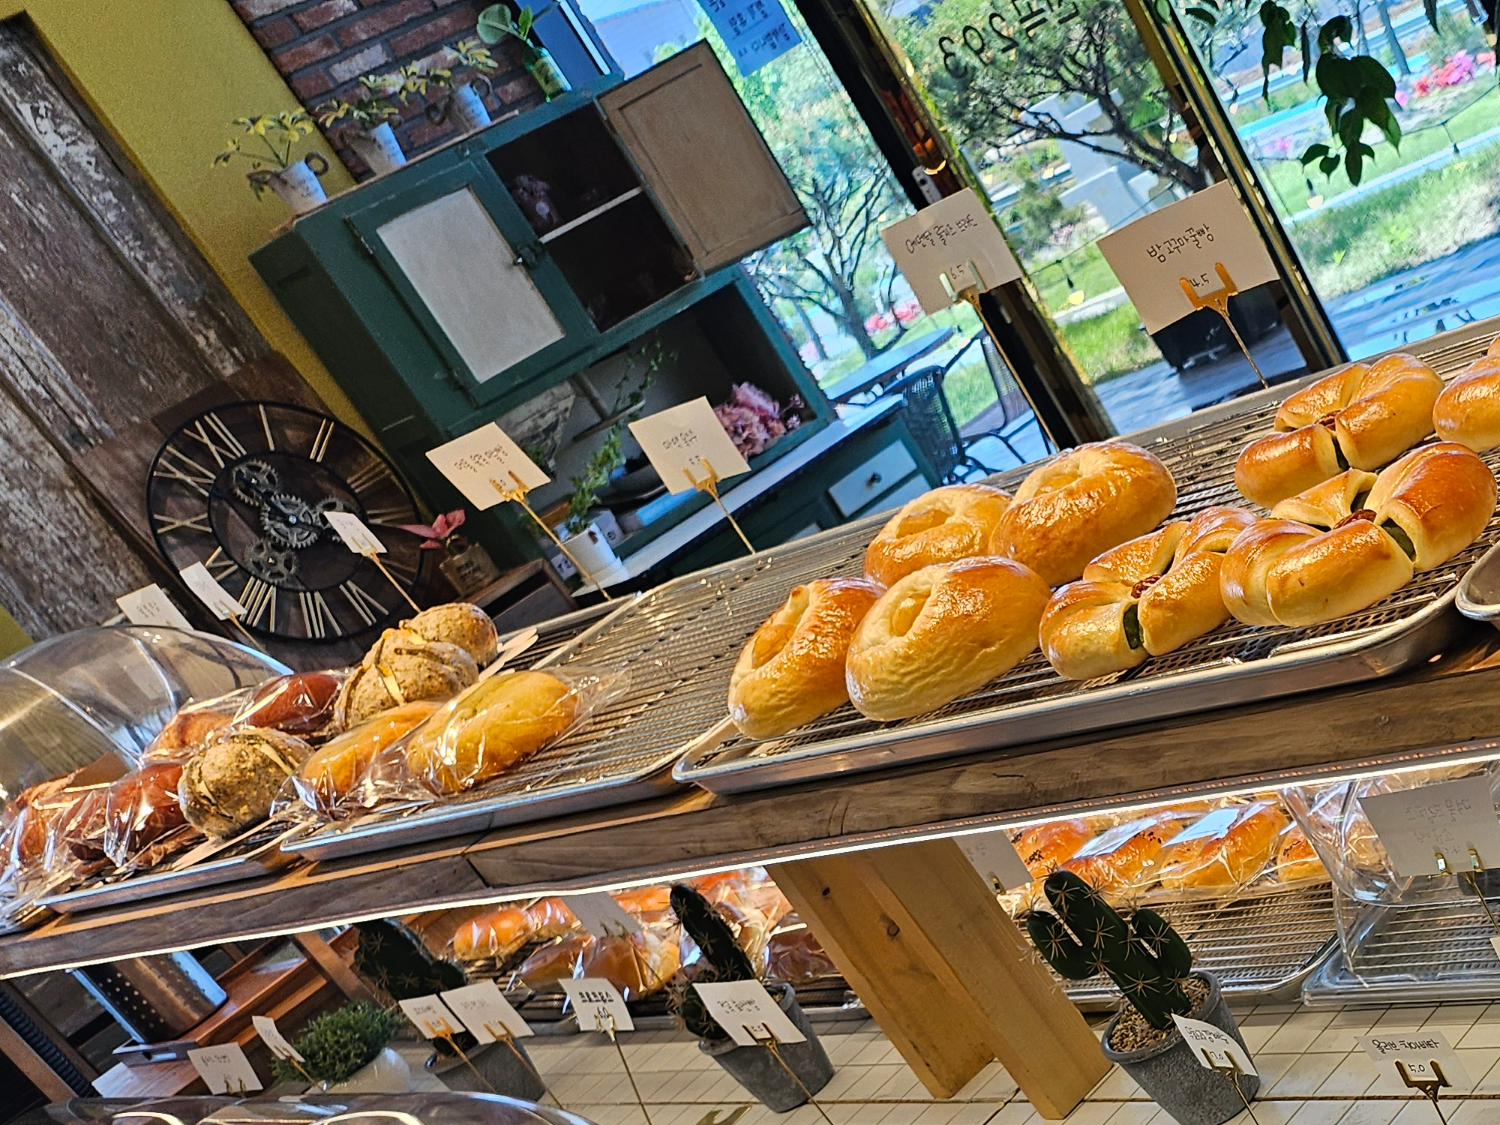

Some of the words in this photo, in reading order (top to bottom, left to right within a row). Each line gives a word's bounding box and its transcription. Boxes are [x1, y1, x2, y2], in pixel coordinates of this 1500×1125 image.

[949, 264, 964, 280] 6.5
[1189, 272, 1210, 288] 4.5
[1372, 1038, 1400, 1054] 올리브
[1399, 1038, 1440, 1050] 치아바타
[1407, 1063, 1426, 1073] 5.0
